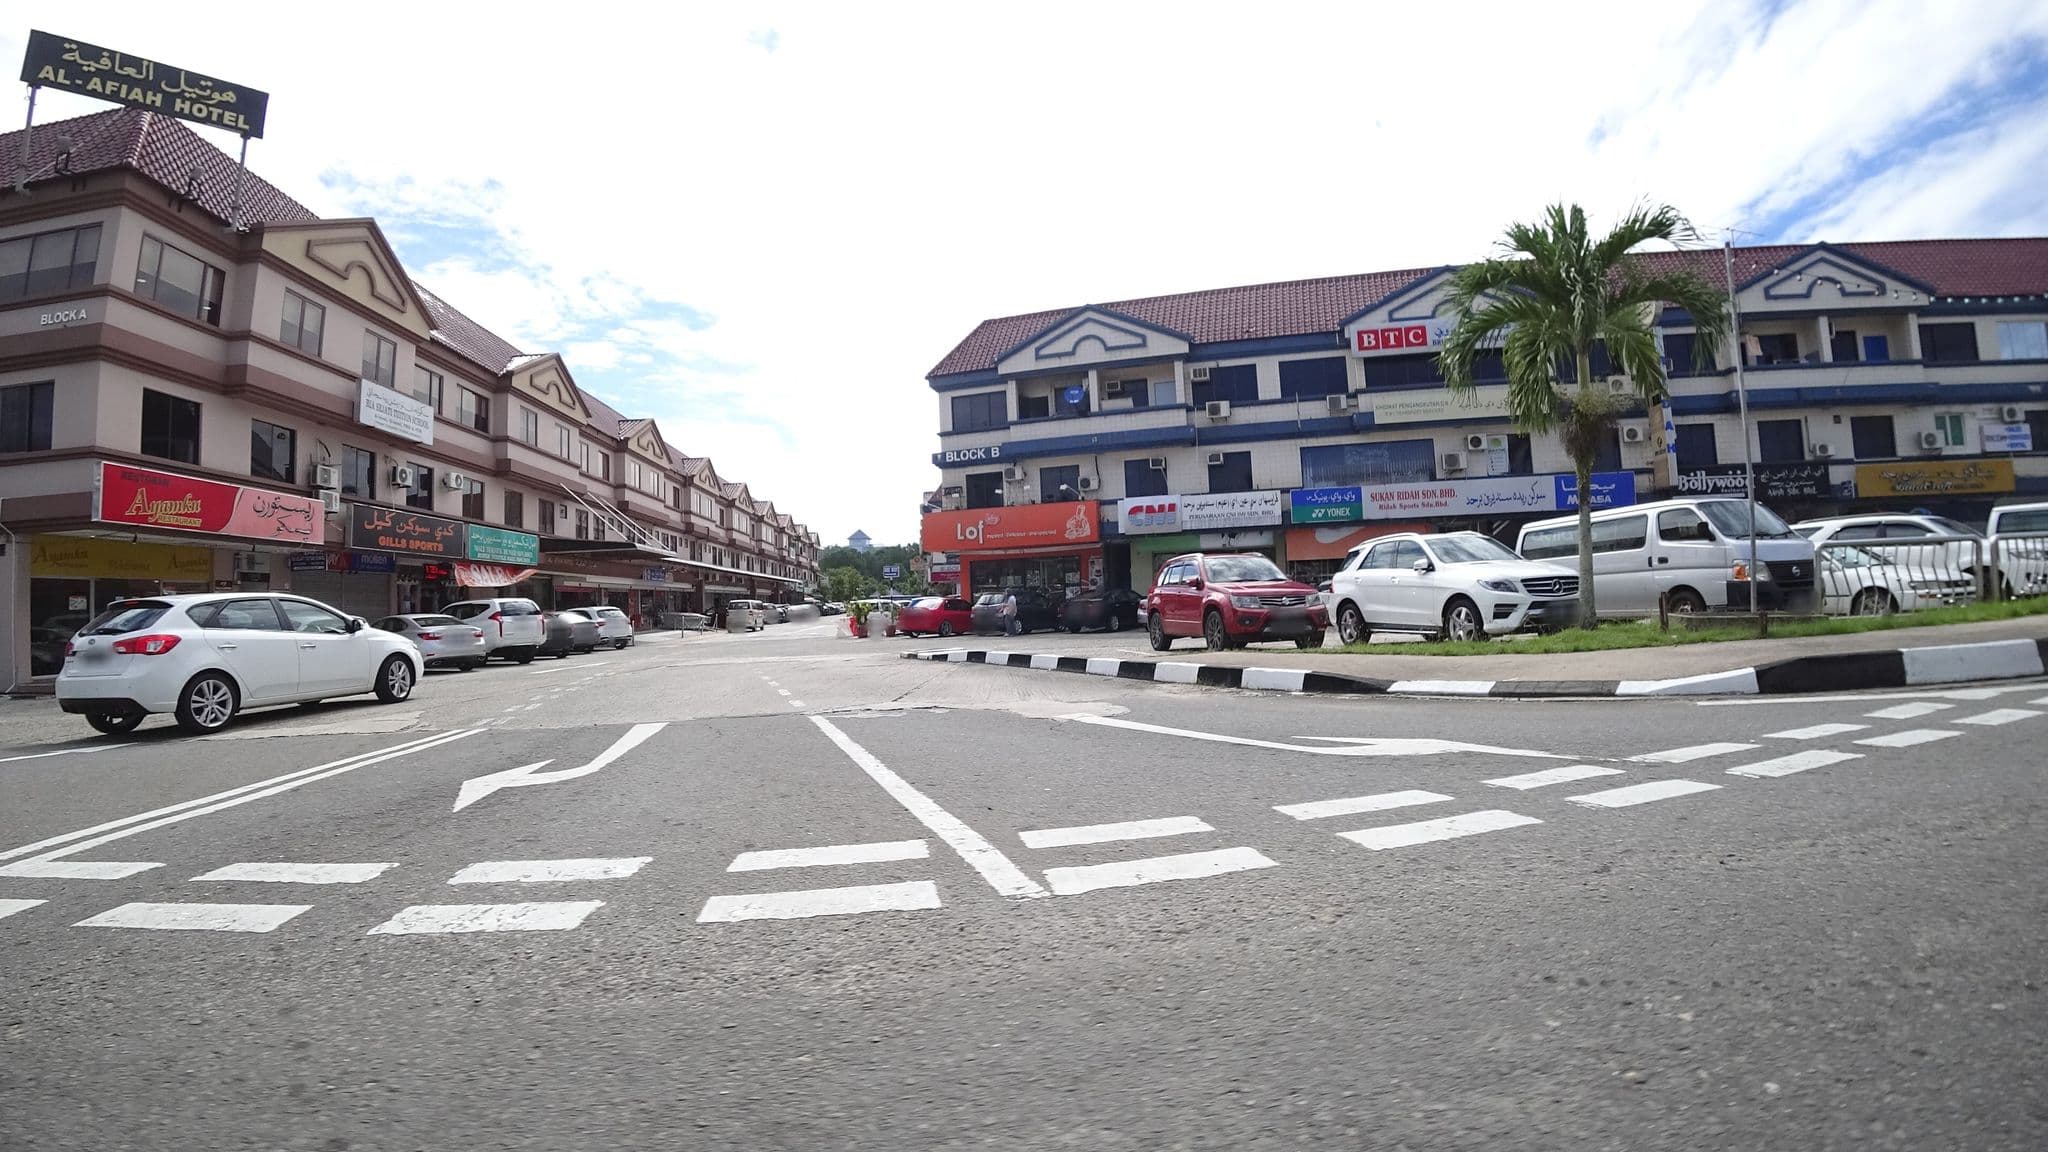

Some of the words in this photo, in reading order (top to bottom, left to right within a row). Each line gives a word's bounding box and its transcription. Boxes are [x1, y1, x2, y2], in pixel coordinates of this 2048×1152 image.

[61, 42, 155, 81] العافية
[174, 99, 250, 130] HOTEL
[40, 310, 78, 325] BLOCK
[78, 308, 88, 320] A
[1362, 328, 1423, 348] BTC
[945, 448, 986, 462] BLOCK
[991, 447, 1000, 458] B
[1370, 491, 1394, 503] SUKAN
[1396, 489, 1420, 501] RIDAH
[1421, 489, 1438, 500] SDN.
[1440, 488, 1458, 498] BHD.
[1566, 494, 1613, 505] MASA
[125, 487, 202, 523] Ayamku
[1327, 507, 1351, 518] YONEX
[1399, 501, 1420, 511] Sports
[157, 514, 202, 527] RESTAURANT
[956, 520, 984, 544] Lof
[378, 535, 407, 549] GILLS
[409, 539, 444, 552] SPORTS
